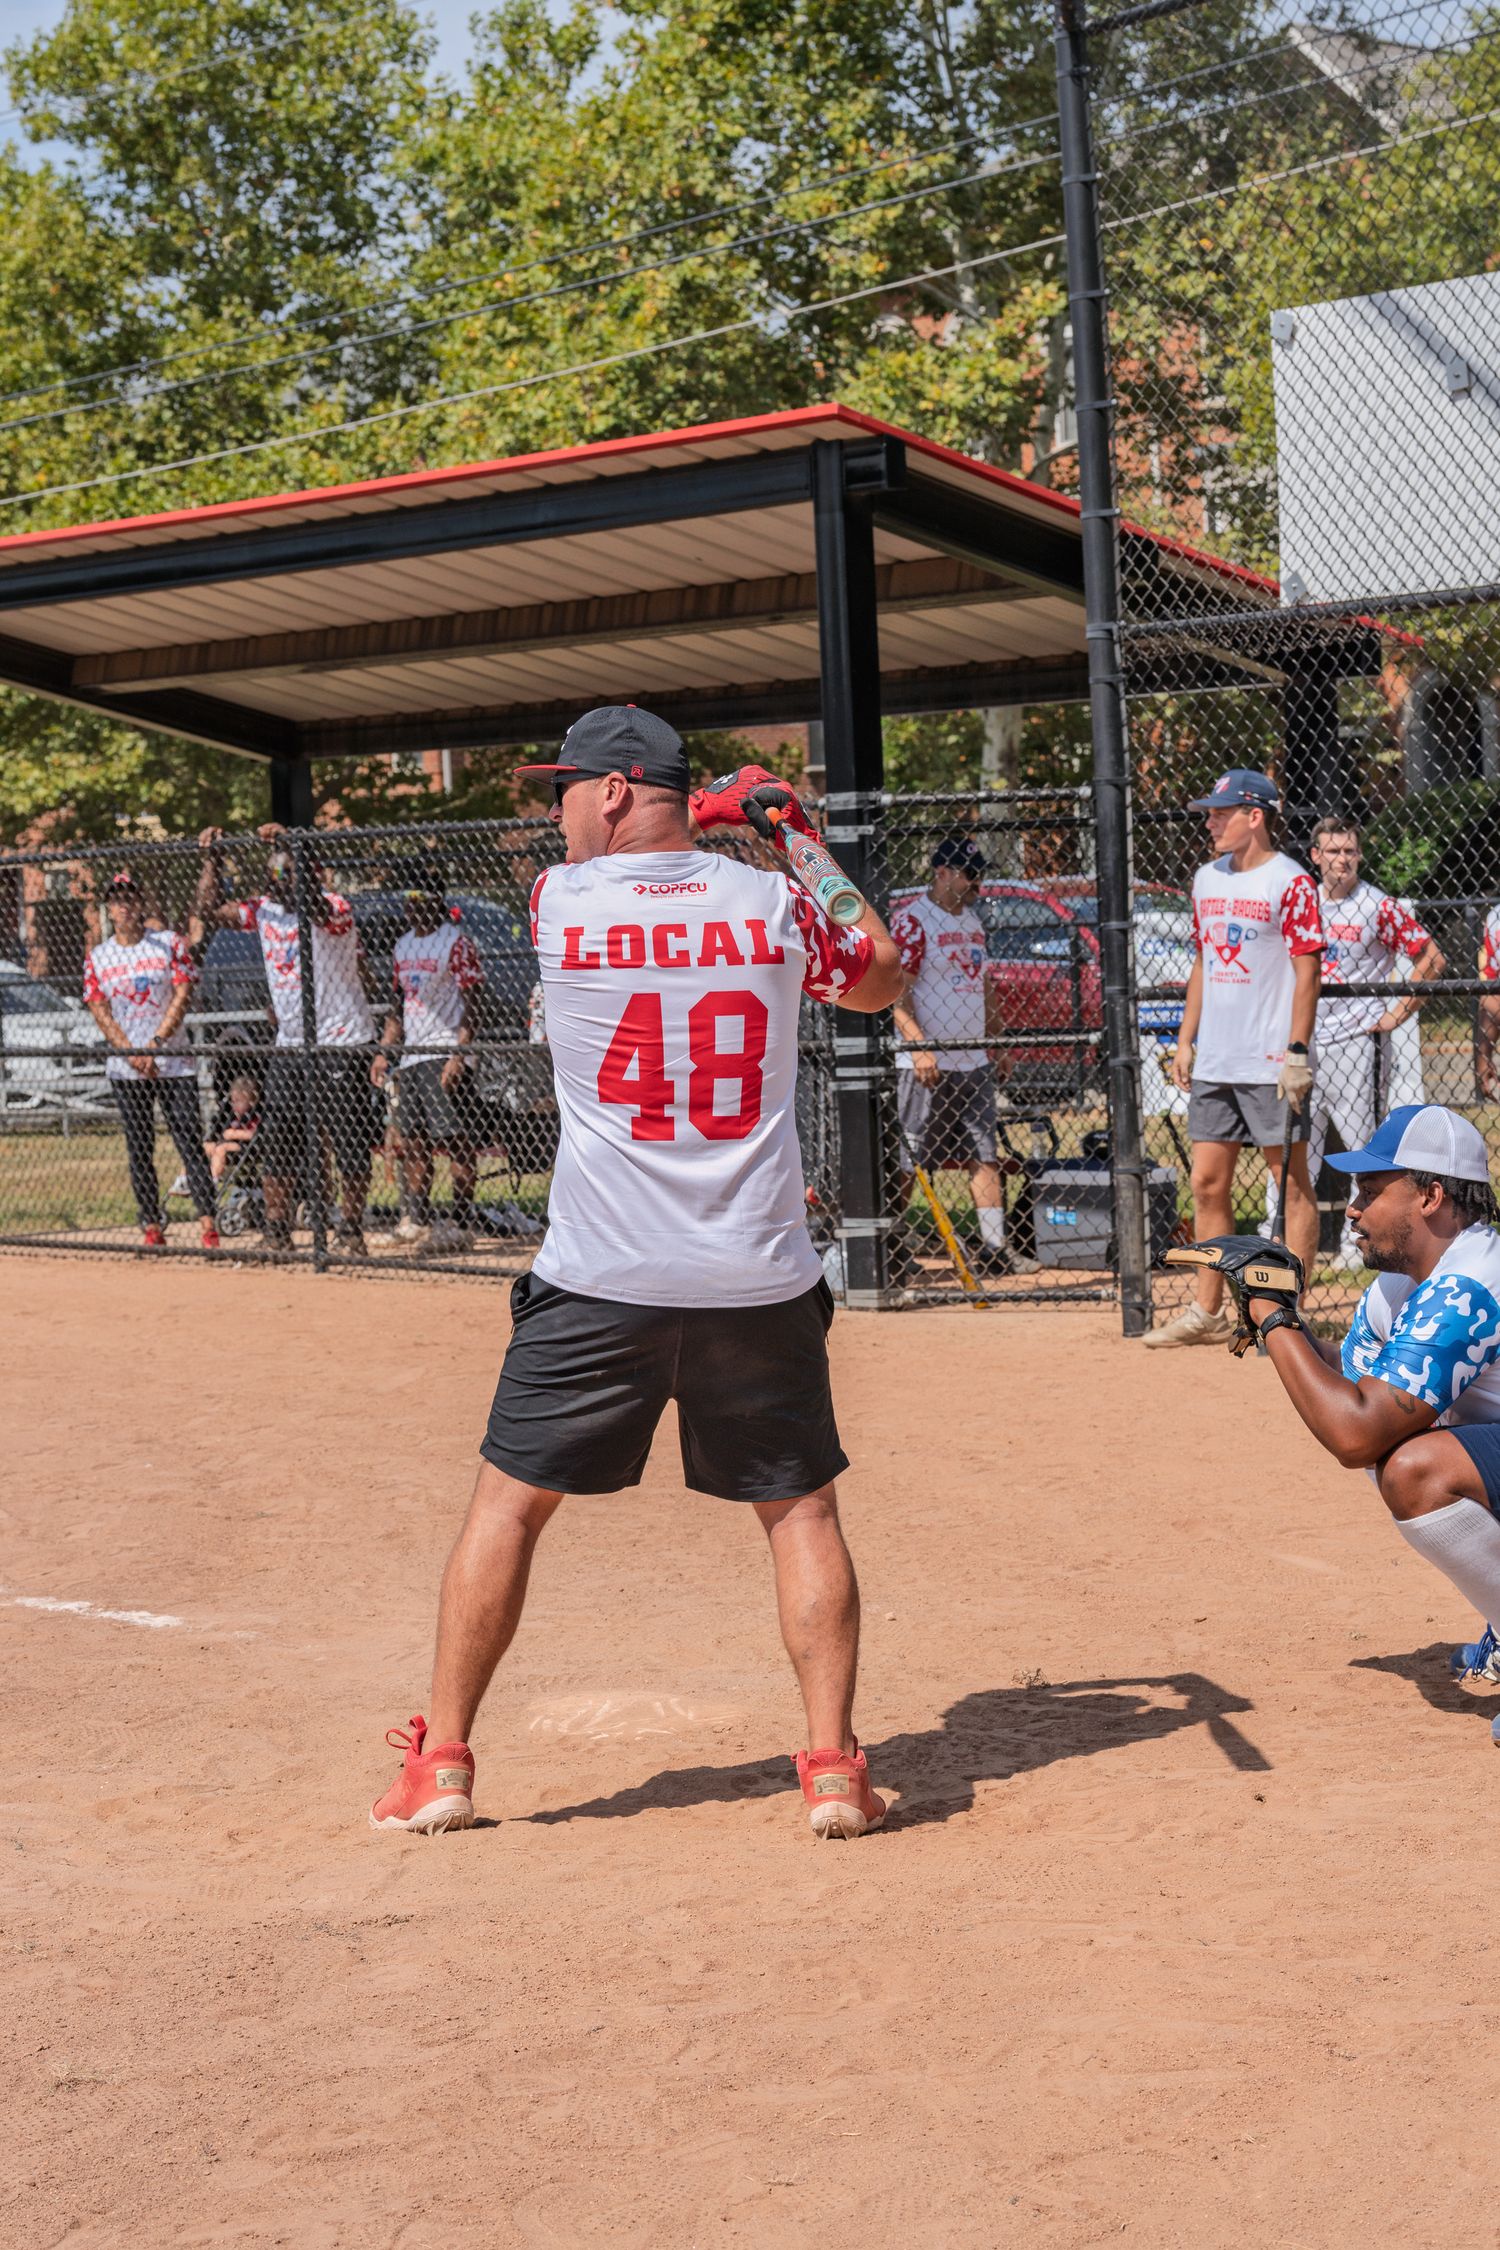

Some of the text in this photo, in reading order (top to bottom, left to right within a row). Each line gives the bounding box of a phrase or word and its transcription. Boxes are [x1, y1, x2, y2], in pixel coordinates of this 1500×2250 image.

[649, 882, 707, 894] COPFCU
[561, 919, 785, 970] LOCAL
[597, 990, 769, 1141] 48
